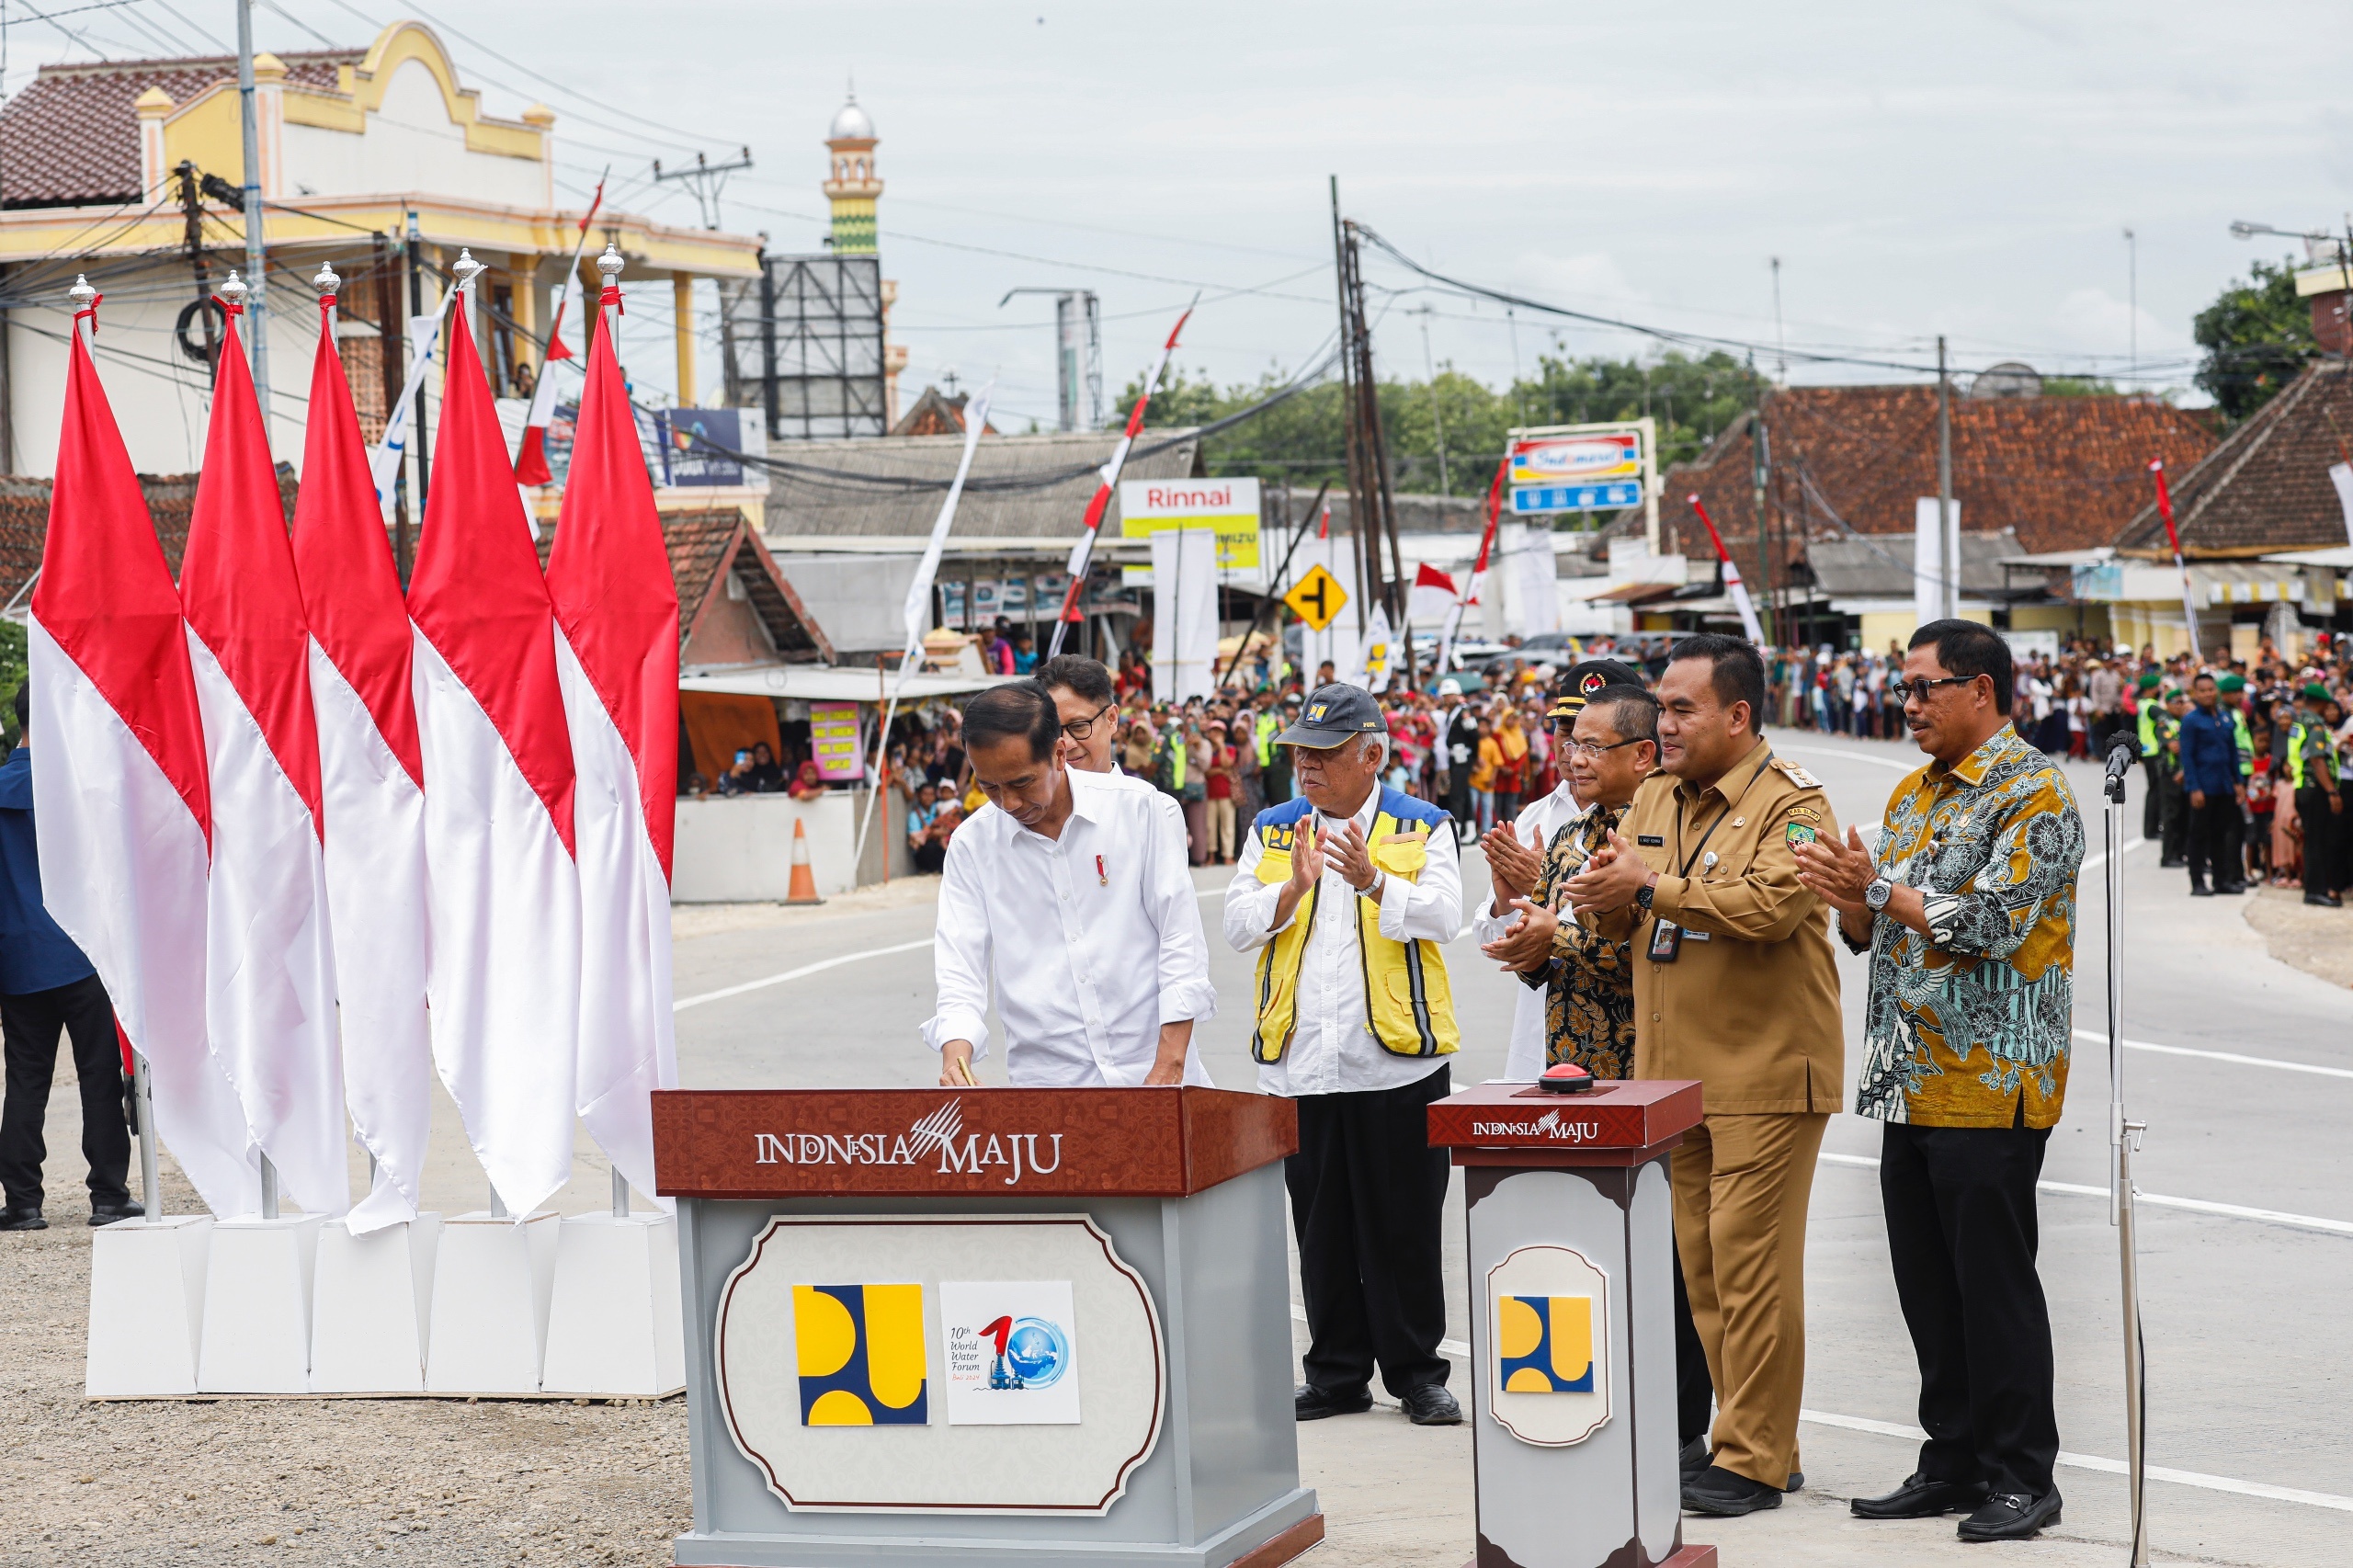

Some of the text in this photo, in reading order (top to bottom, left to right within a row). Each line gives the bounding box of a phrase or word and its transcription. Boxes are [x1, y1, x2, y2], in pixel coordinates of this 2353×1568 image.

[1148, 484, 1231, 508] Rinnai
[1472, 1122, 1599, 1143] INDONESIA MAJU
[755, 1133, 1063, 1186] INDONESIA MAJU
[950, 1326, 971, 1339] 10th
[950, 1340, 978, 1351] World
[951, 1352, 979, 1361] Water
[951, 1362, 980, 1371] Forum
